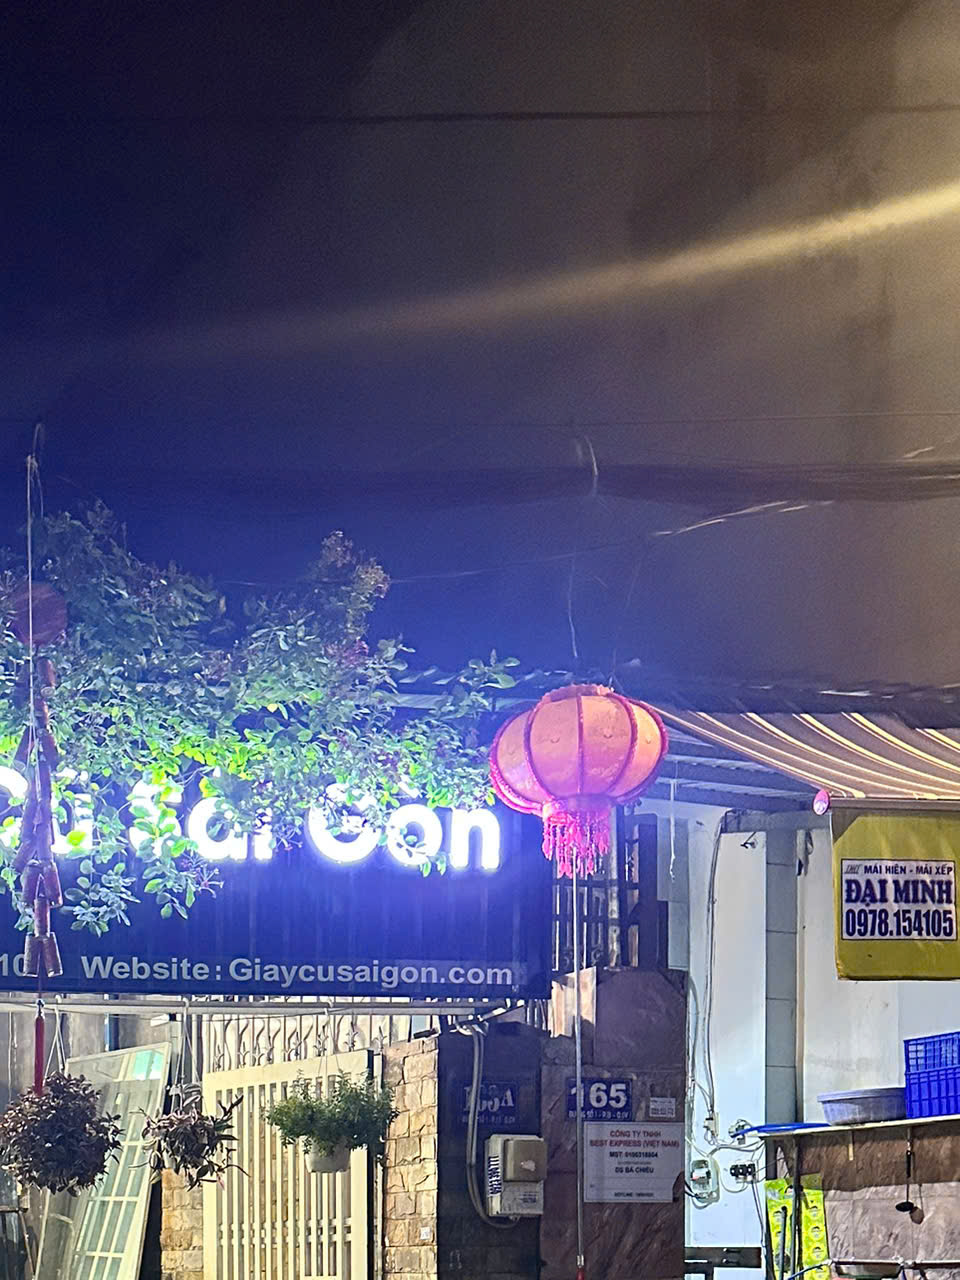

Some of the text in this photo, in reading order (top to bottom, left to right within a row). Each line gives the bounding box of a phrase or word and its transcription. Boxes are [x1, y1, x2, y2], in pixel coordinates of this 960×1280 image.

[863, 864, 882, 875] MÁI
[885, 863, 907, 875] HIÊN
[935, 863, 953, 876] XẾP
[844, 878, 953, 907] ĐẠI MINH
[845, 908, 954, 937] 0978.154105
[570, 1082, 628, 1109] 165
